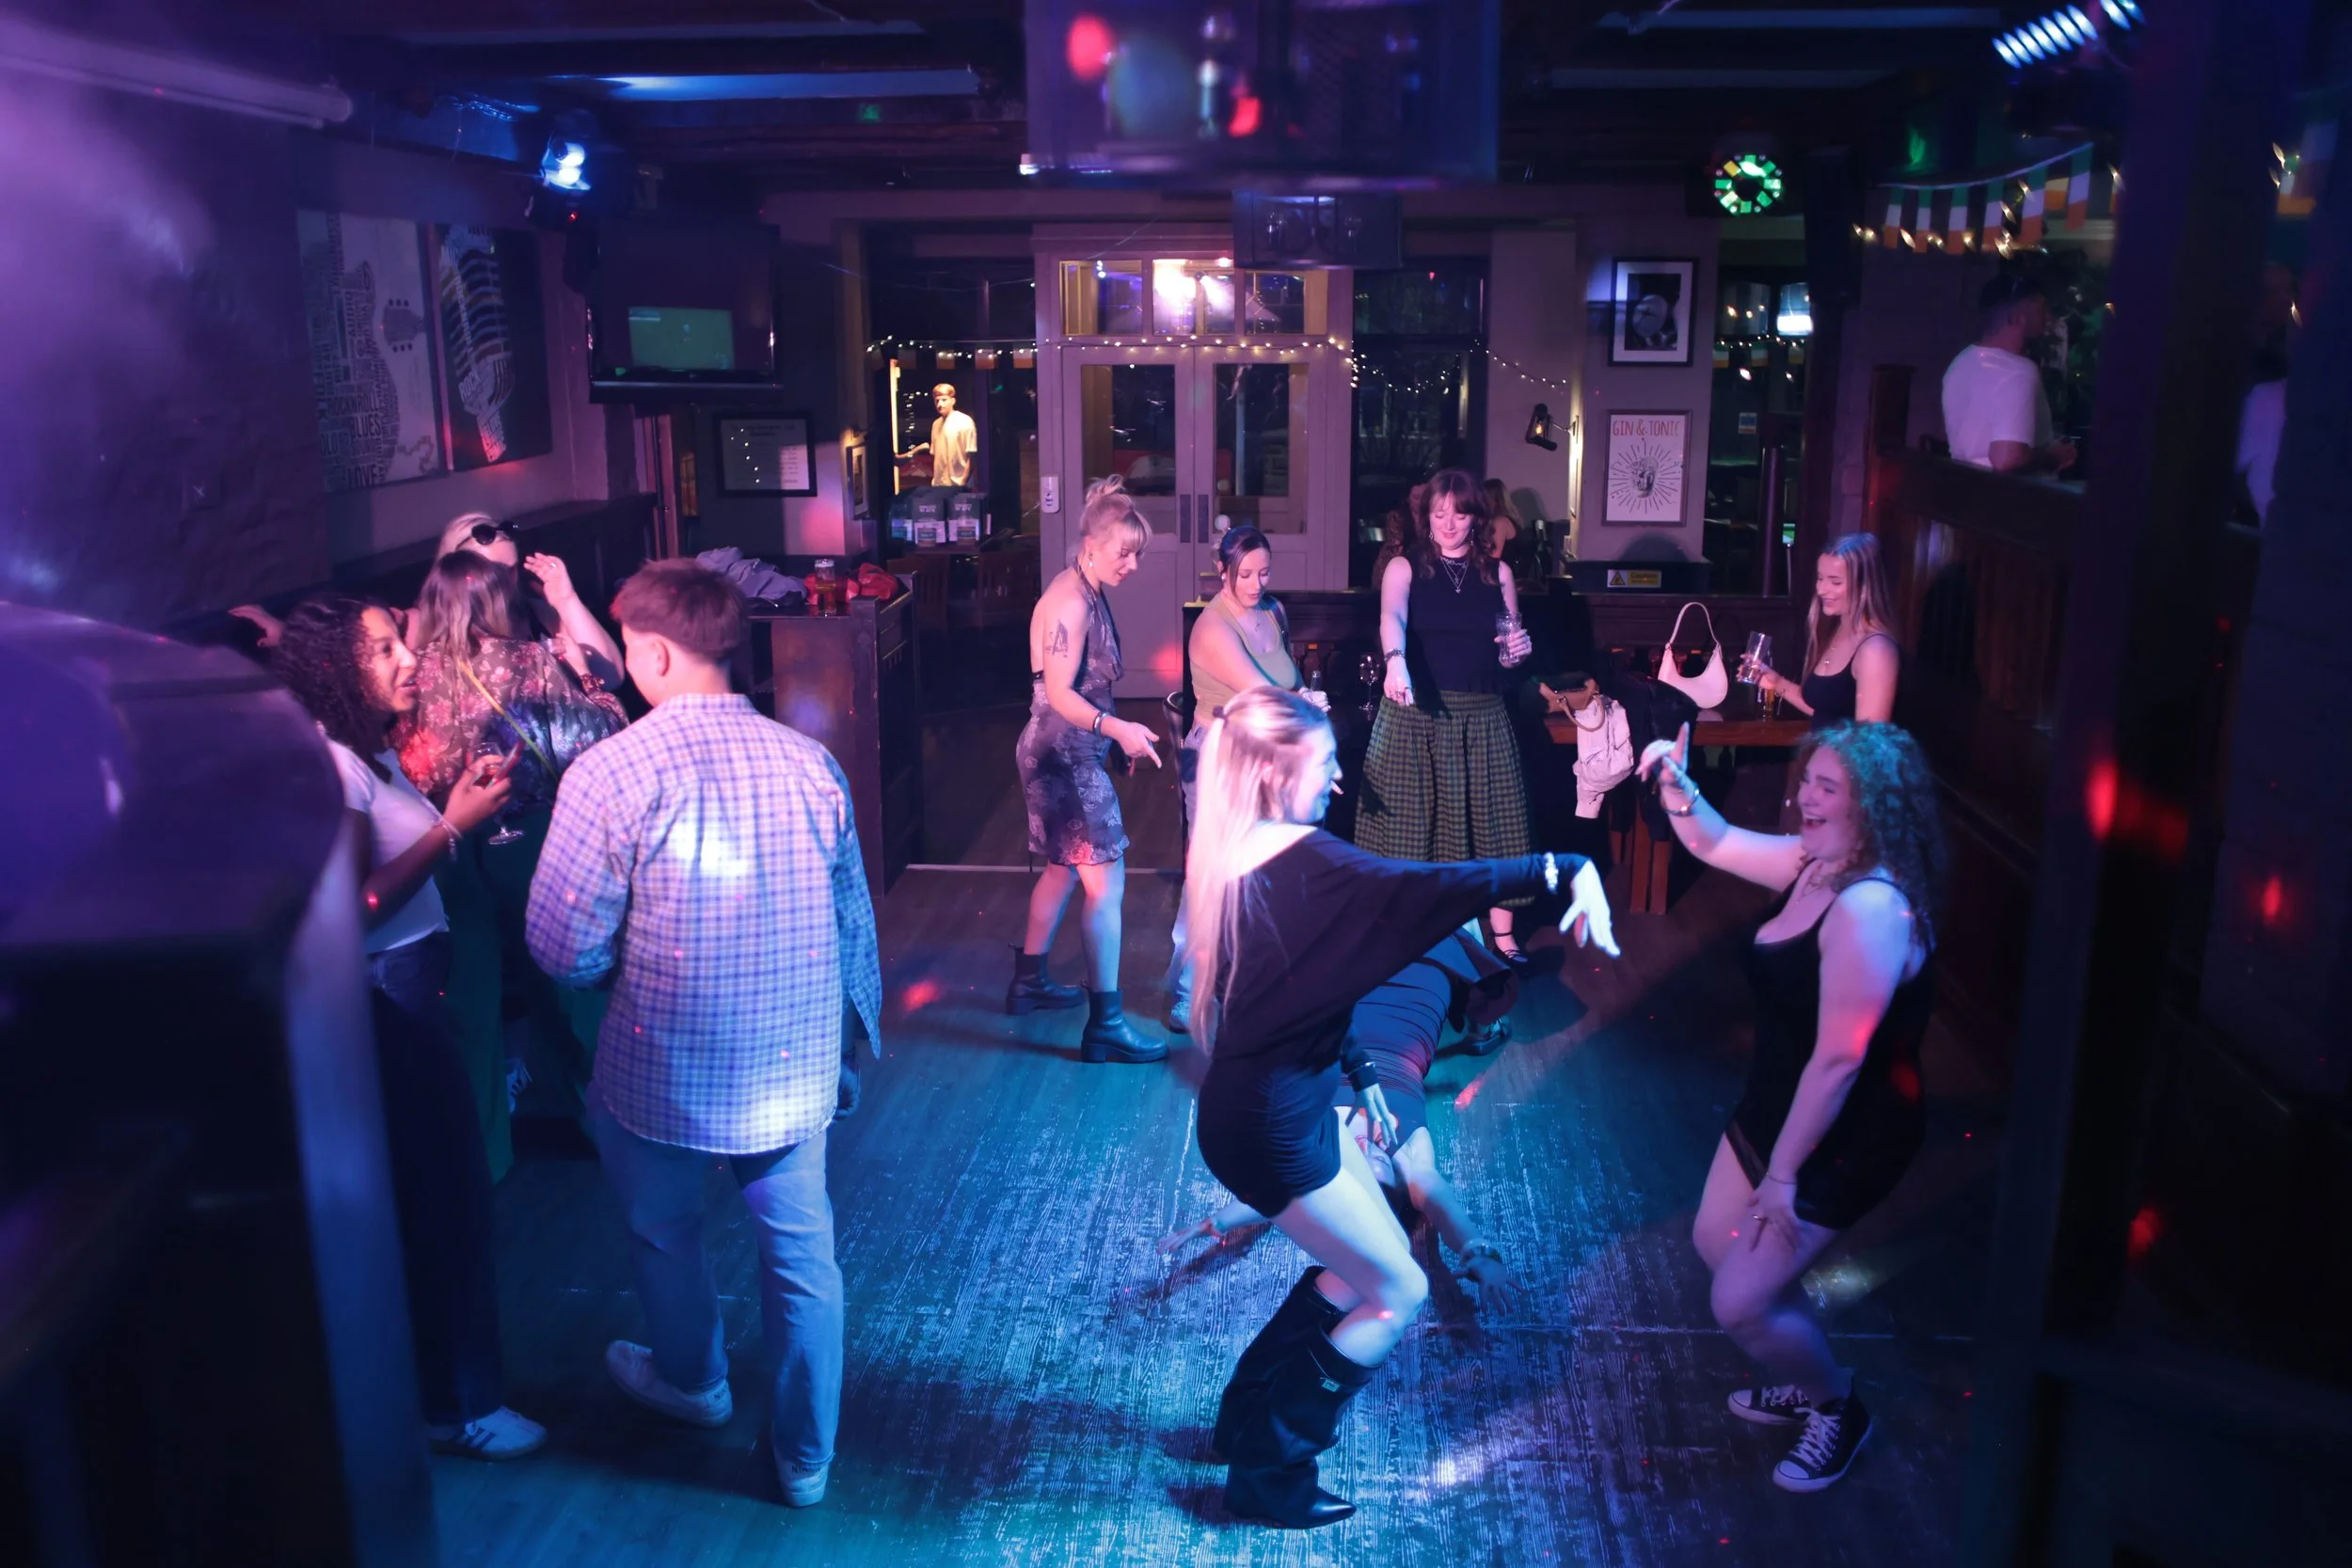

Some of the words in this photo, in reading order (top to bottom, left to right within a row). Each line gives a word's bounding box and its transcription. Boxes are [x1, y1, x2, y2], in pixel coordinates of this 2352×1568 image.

[458, 371, 481, 403] ROCK
[349, 413, 381, 437] BLUES
[1613, 420, 1633, 436] GIN
[1636, 419, 1645, 436] &
[1648, 420, 1681, 436] TONIC
[321, 432, 338, 456] OLD
[348, 464, 376, 490] LOVE
